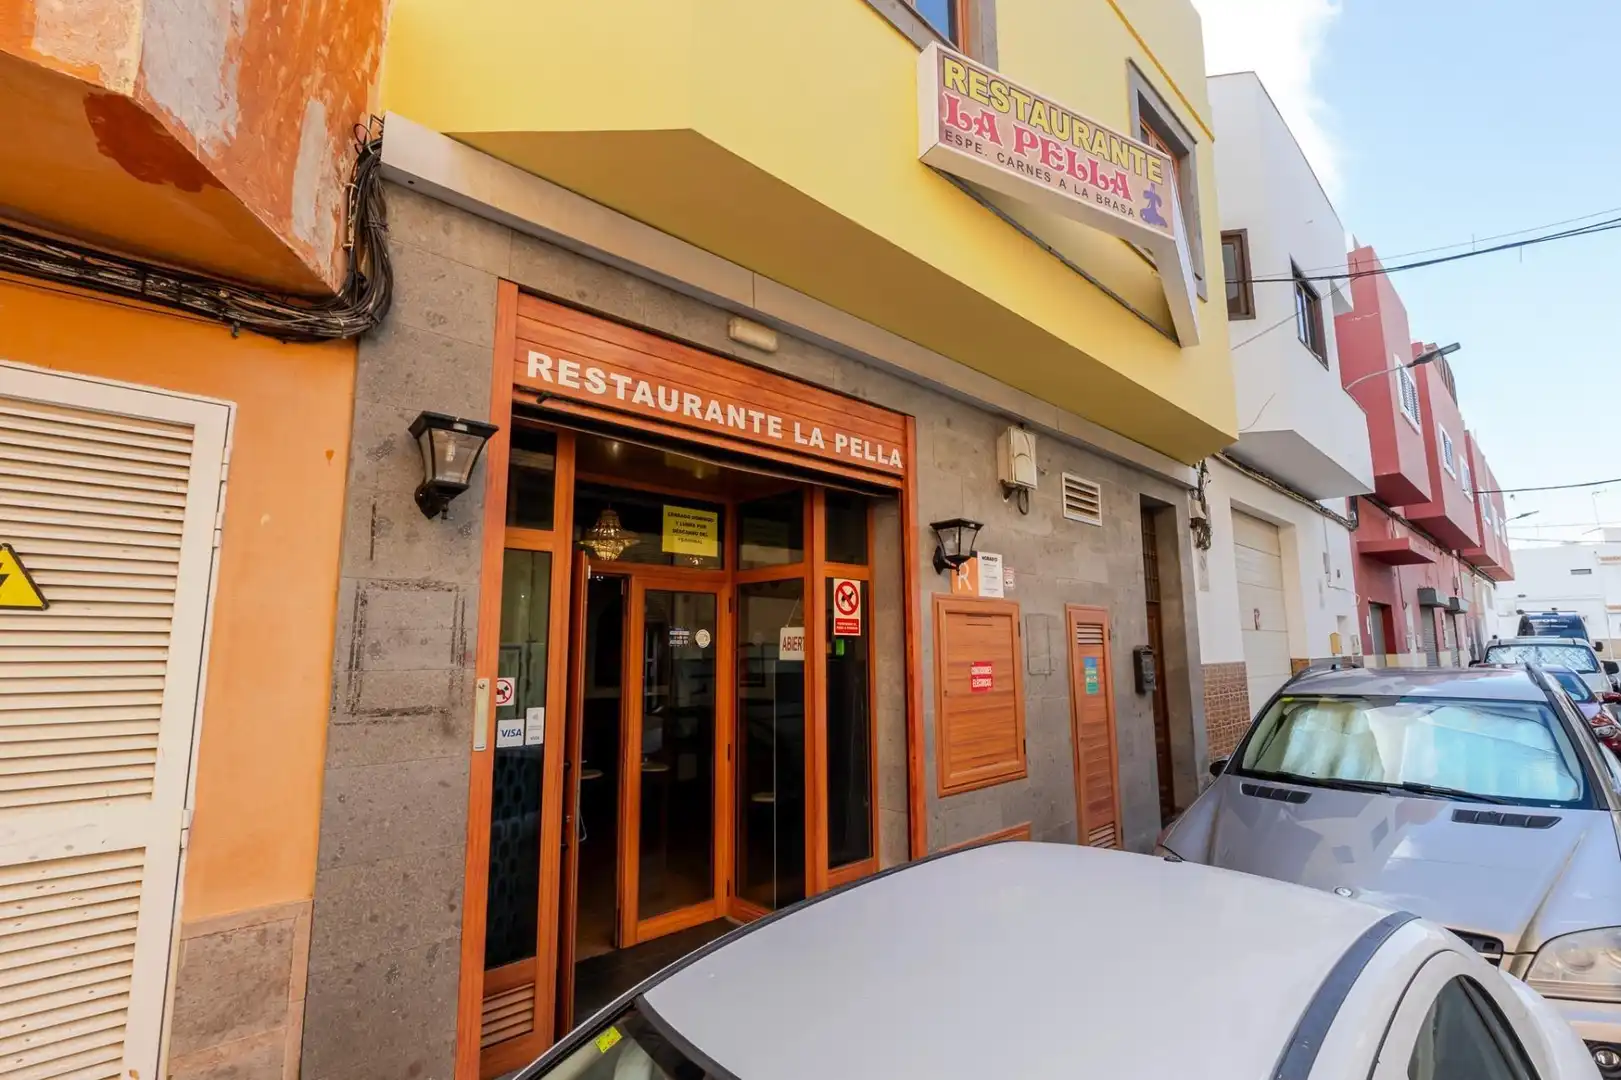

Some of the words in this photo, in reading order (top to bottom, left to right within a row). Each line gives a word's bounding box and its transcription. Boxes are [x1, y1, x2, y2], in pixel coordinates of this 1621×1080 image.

[942, 92, 1002, 147] LA
[1012, 123, 1133, 201] PELLA
[943, 55, 1163, 185] RESTAURANTE
[945, 129, 988, 157] ESPE.
[997, 153, 1051, 183] CARNES
[1059, 179, 1067, 190] A
[1074, 184, 1089, 198] LA
[1096, 193, 1135, 217] BRASA
[527, 350, 783, 440] RESTAURANTE
[794, 422, 825, 449] LA
[835, 432, 903, 468] PELLA
[782, 636, 805, 651] ABIERT
[501, 729, 522, 737] VISA
